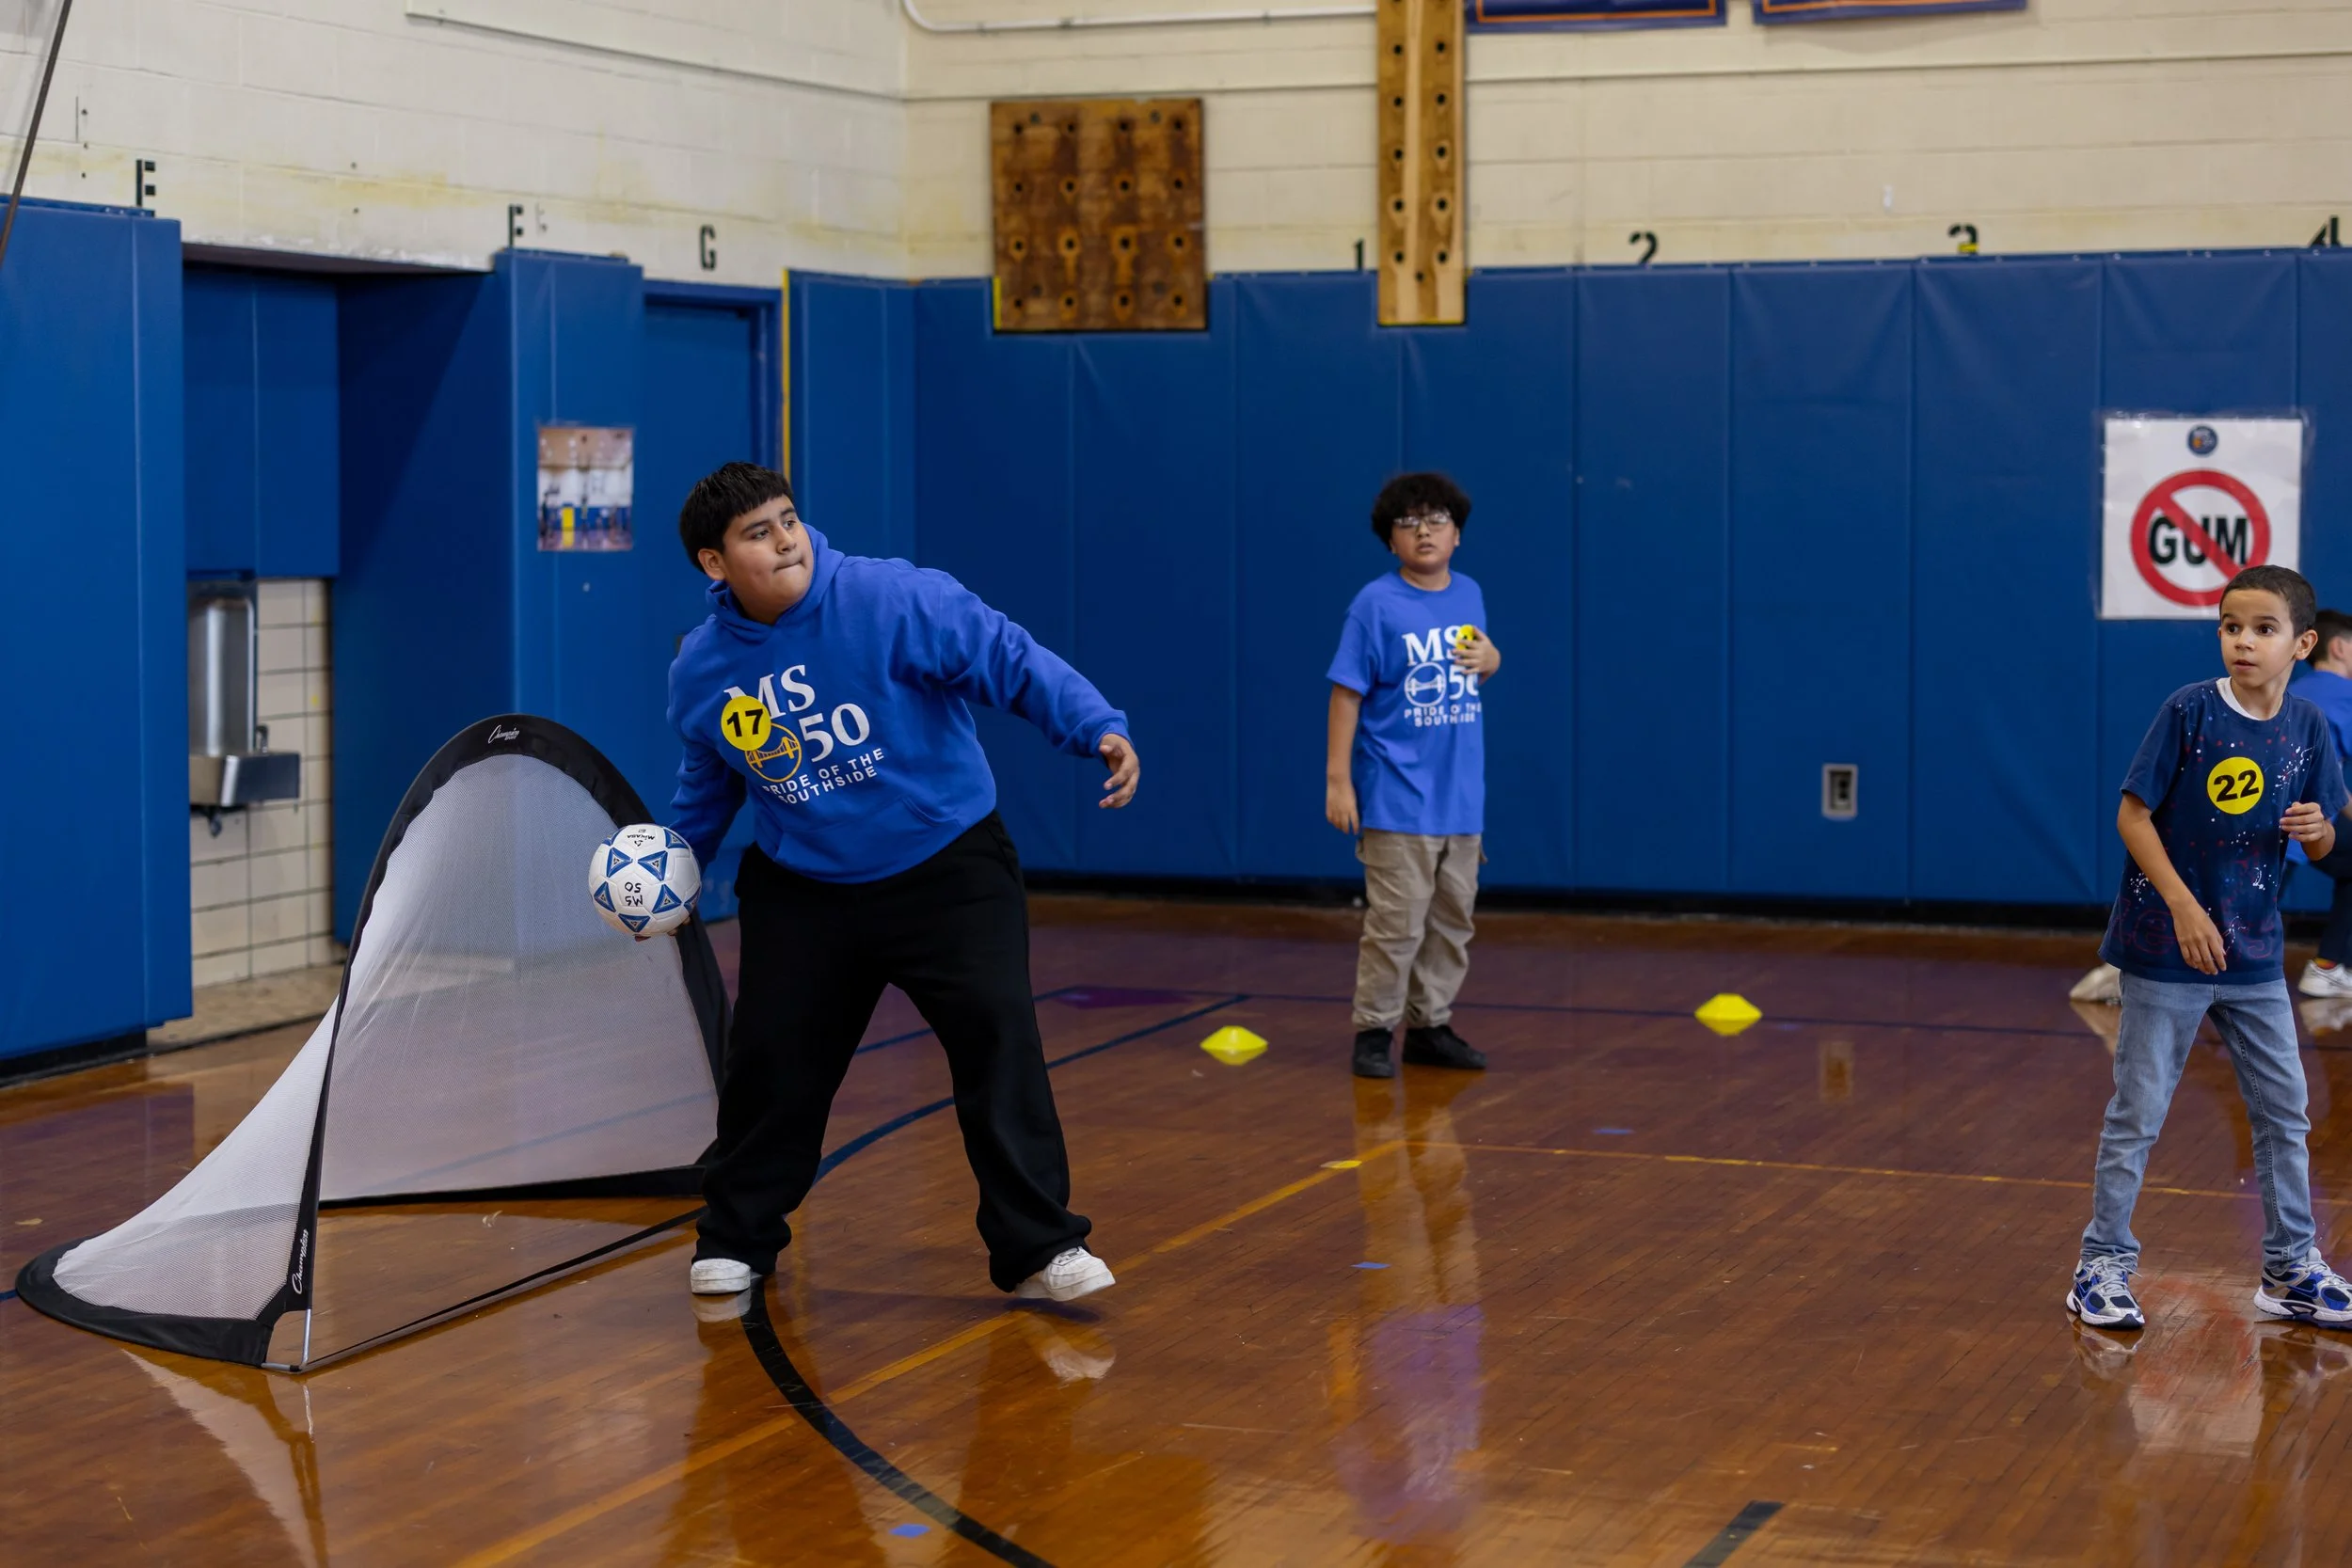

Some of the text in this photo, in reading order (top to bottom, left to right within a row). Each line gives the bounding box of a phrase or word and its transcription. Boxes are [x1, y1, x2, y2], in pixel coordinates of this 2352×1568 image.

[700, 225, 717, 272] G
[1629, 230, 1659, 266] 2
[2148, 515, 2249, 566] GUM
[723, 664, 816, 721] MS
[726, 708, 764, 738] 17
[798, 703, 870, 763] 50
[1414, 712, 1476, 727] SOUTHIDE
[762, 748, 884, 795] PRIDE OF THE
[778, 766, 877, 804] SOUTHSIDE
[2213, 769, 2260, 802] 22
[624, 881, 642, 894] 50
[625, 895, 644, 907] MS
